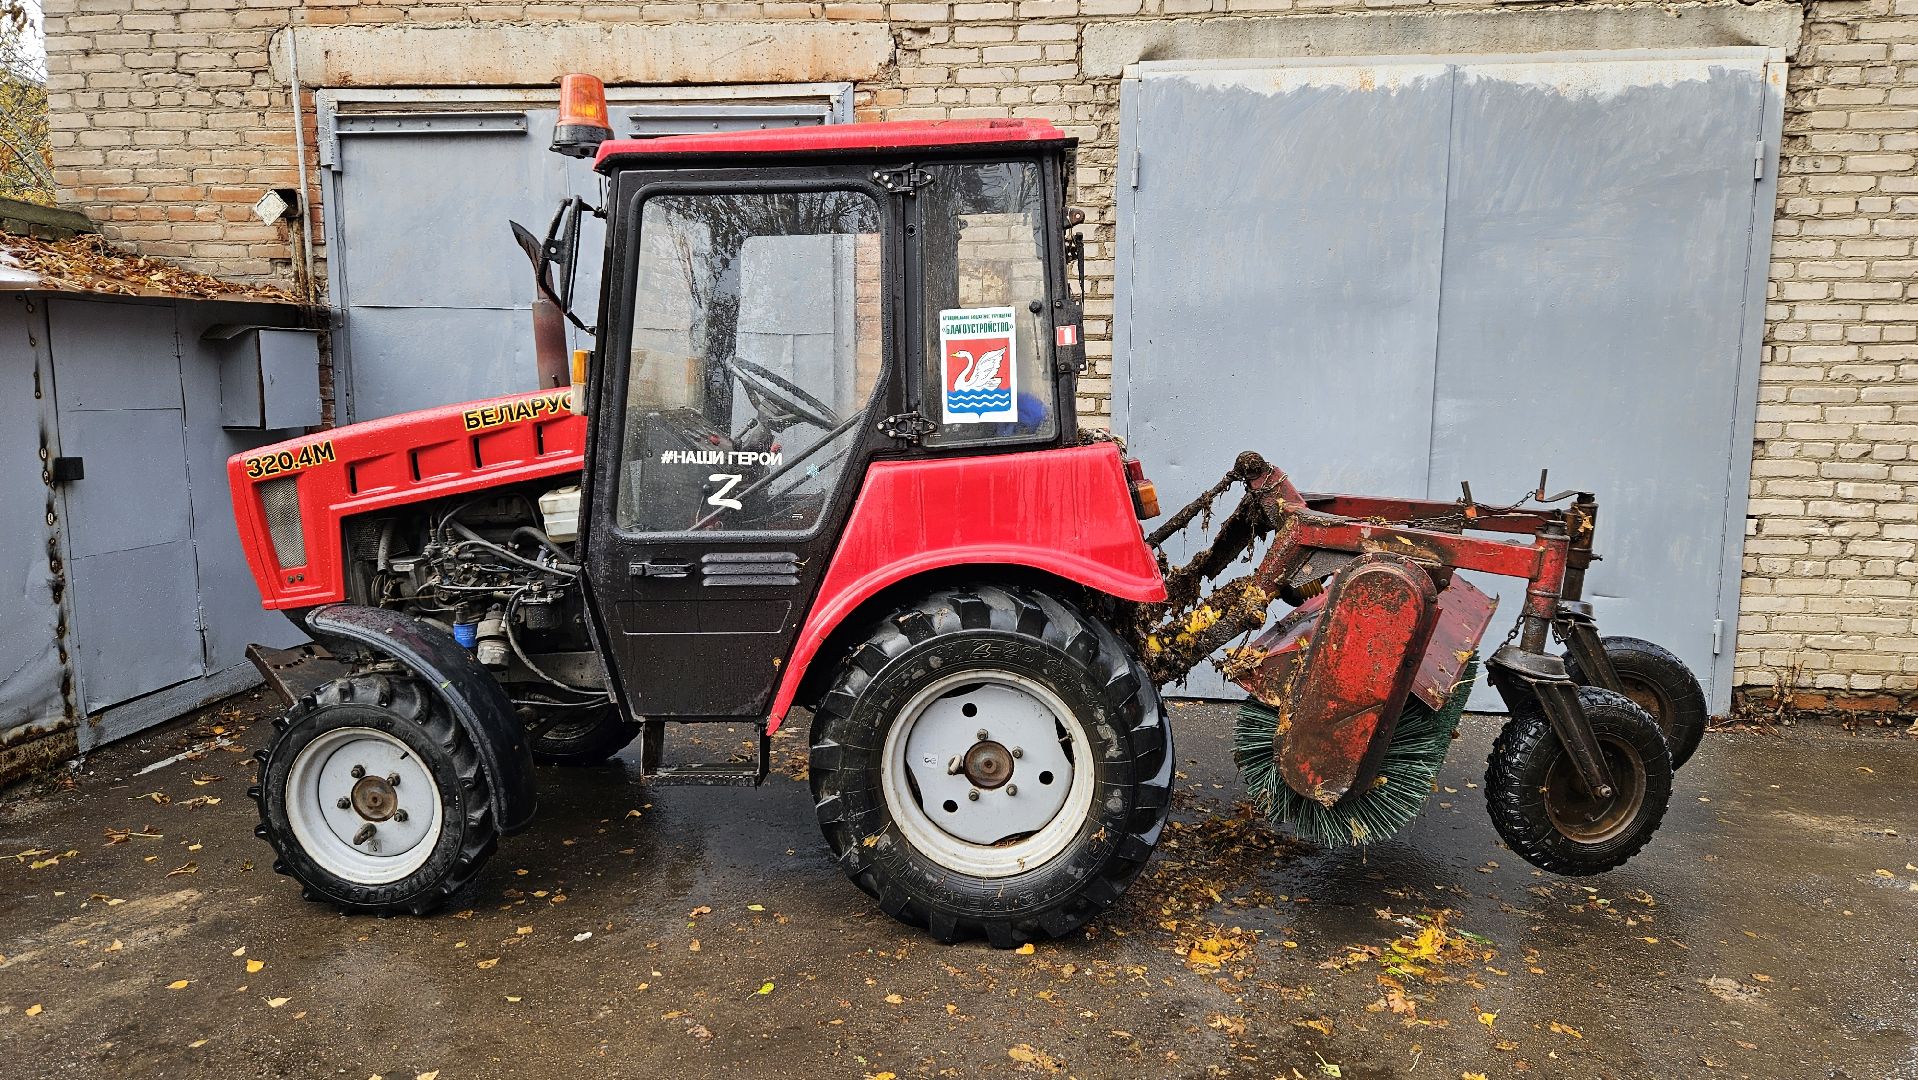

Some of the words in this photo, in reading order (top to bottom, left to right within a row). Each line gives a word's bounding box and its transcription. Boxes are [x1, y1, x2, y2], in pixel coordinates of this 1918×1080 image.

[660, 450, 724, 465] #НАШИ
[728, 451, 783, 466] ГЕРОИ
[707, 473, 743, 511] Z
